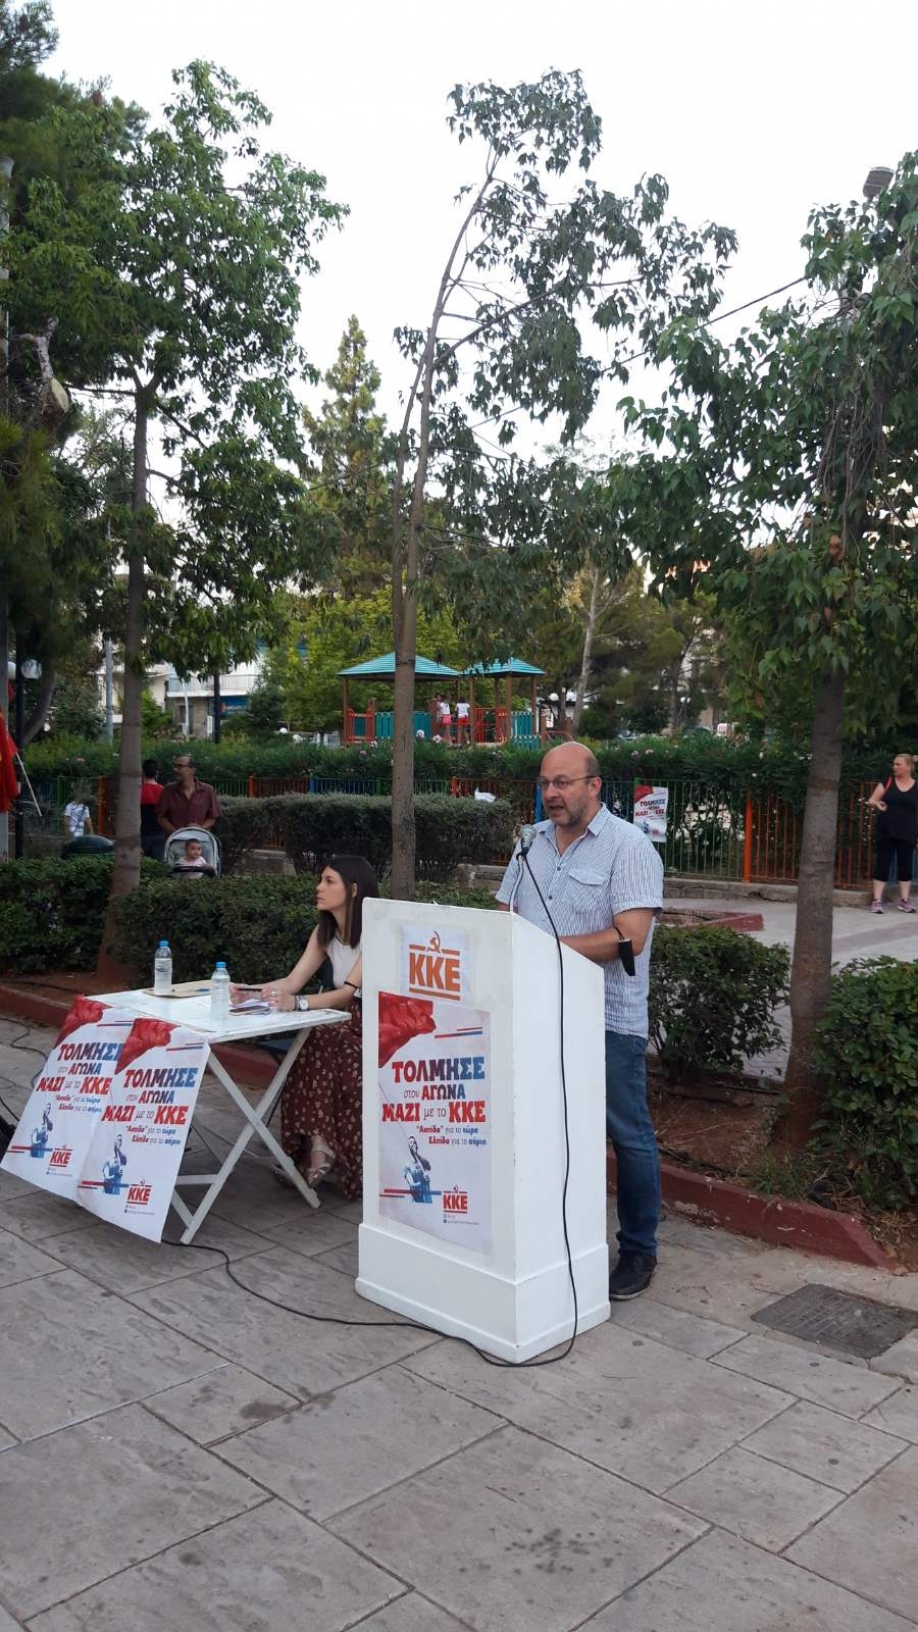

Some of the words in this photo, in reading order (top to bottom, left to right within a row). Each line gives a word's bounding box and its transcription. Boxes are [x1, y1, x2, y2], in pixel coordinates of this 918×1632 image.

[409, 952, 460, 992] ΚΚΕ
[68, 1063, 102, 1075] ΑΓΩΝΑ
[392, 1056, 485, 1083] ΤΟΛΜΗΣΕ
[36, 1077, 65, 1092] ΜΑΖΙ
[80, 1077, 113, 1095] ΚΚΕ
[123, 1068, 198, 1088] ΤΟΛΜΗΣΕ
[138, 1090, 175, 1104] ΑΓΩΝΑ
[421, 1084, 466, 1100] ΑΓΩΝΑ
[102, 1106, 136, 1122] ΜΑΖΙ
[154, 1106, 189, 1125] ΚΚΕ
[382, 1103, 420, 1122] ΜΑΖΙ
[424, 1108, 435, 1120] με
[437, 1108, 446, 1117] το
[449, 1100, 486, 1123] ΚΚΕ
[50, 1151, 72, 1165] ΚΚΕ
[127, 1187, 151, 1202] ΚΚΕ
[443, 1195, 468, 1210] ΚΚΕ
